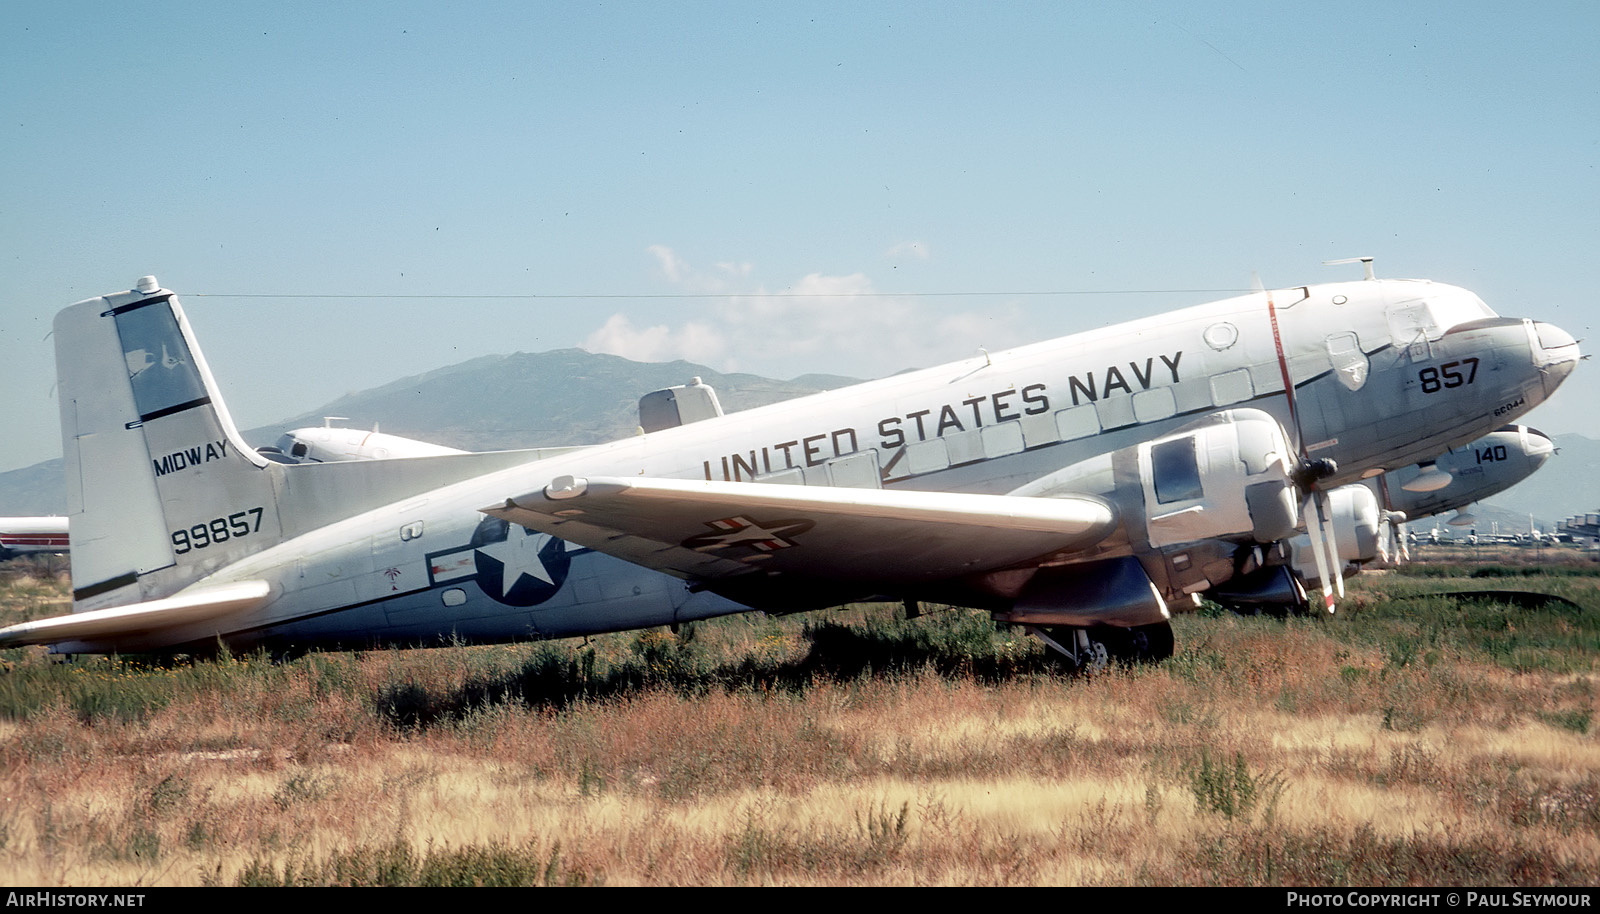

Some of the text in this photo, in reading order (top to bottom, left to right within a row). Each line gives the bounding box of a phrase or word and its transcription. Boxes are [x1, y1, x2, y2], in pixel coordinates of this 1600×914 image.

[1418, 357, 1480, 394] 857
[703, 351, 1183, 482] UNITED STATES NAVY
[153, 439, 228, 477] MIDWAY
[1475, 445, 1507, 465] 140
[171, 506, 264, 555] 99857
